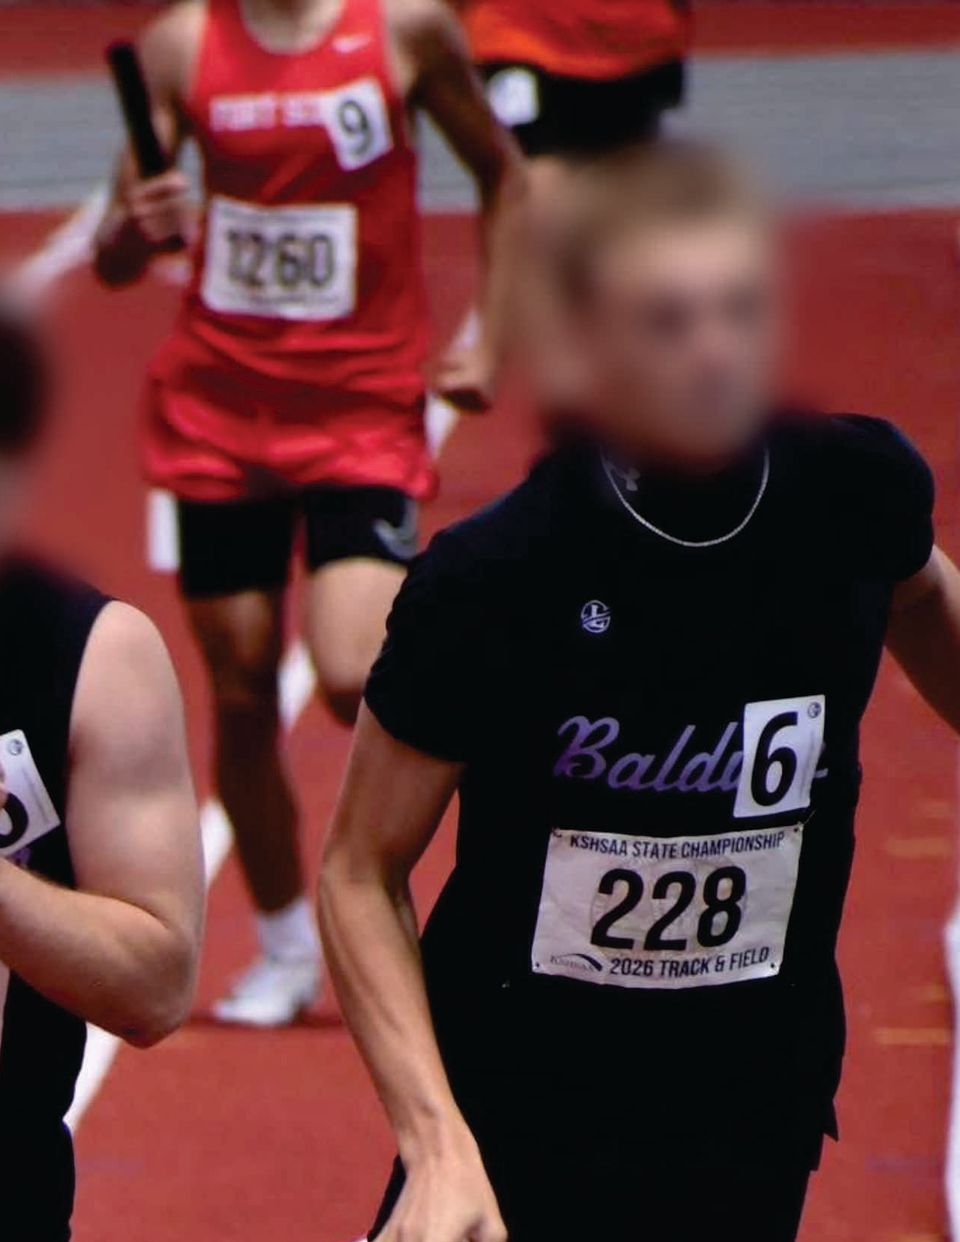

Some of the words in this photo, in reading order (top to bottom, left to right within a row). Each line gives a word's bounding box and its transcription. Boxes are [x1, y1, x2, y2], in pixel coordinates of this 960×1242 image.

[338, 100, 374, 157] 9
[226, 231, 336, 290] 1260
[553, 715, 829, 792] Bald
[751, 711, 798, 807] 6
[570, 834, 628, 857] KSHSAA
[632, 841, 677, 860] STATE
[681, 831, 785, 858] CHAMPIONSHIP
[590, 866, 747, 951] 228
[609, 957, 654, 978] 2026
[659, 958, 710, 978] TRACK
[714, 956, 726, 974] &
[728, 946, 770, 971] FIELD
